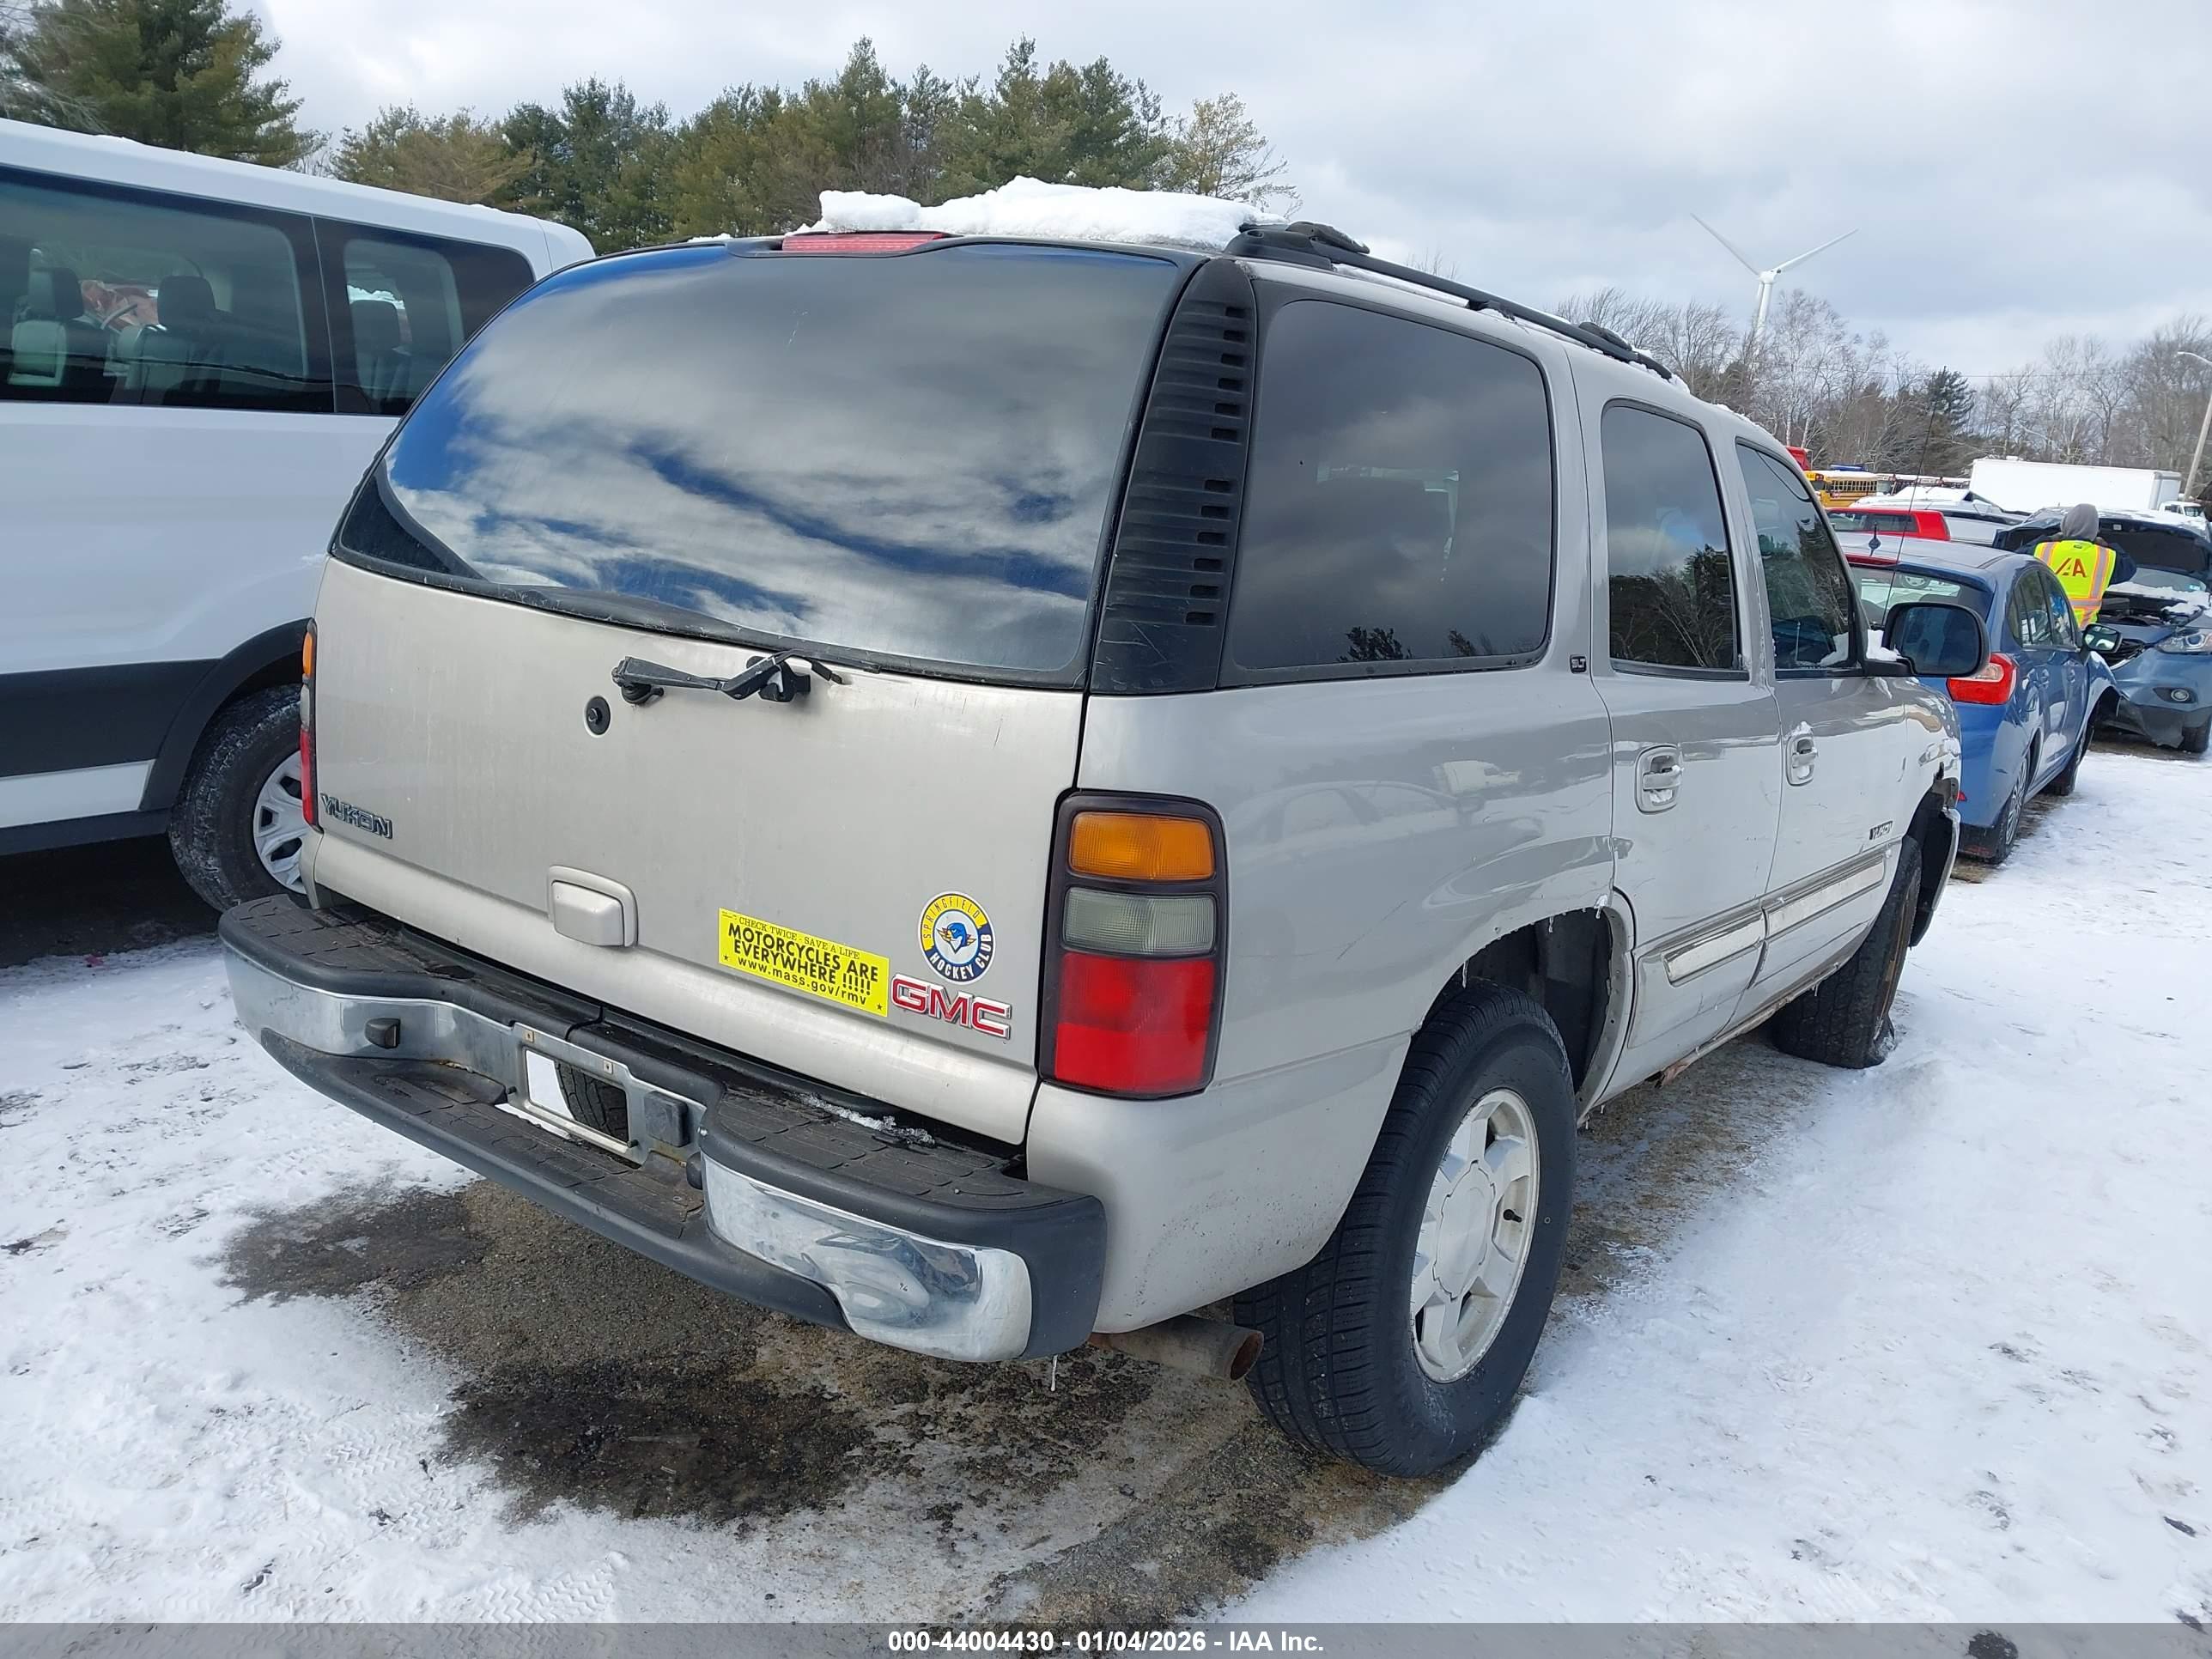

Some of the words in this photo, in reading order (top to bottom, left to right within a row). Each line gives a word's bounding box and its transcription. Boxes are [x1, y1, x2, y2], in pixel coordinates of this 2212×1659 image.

[320, 793, 392, 839] YUKON
[739, 917, 768, 932] CHECK
[770, 926, 797, 940] TWICE
[805, 937, 828, 950] SAVE
[830, 945, 836, 953] A
[839, 947, 860, 959] LIFE
[923, 896, 980, 939] SPRINGFIELD
[728, 922, 841, 970] MOTORCYCLES
[847, 960, 878, 982] ARE
[734, 939, 836, 985] EVERYWHERE
[930, 952, 974, 979] HOCKEY
[975, 934, 992, 969] CLUB
[738, 957, 866, 1005] www.mass.gov/rmv
[891, 973, 1012, 1040] GMC
